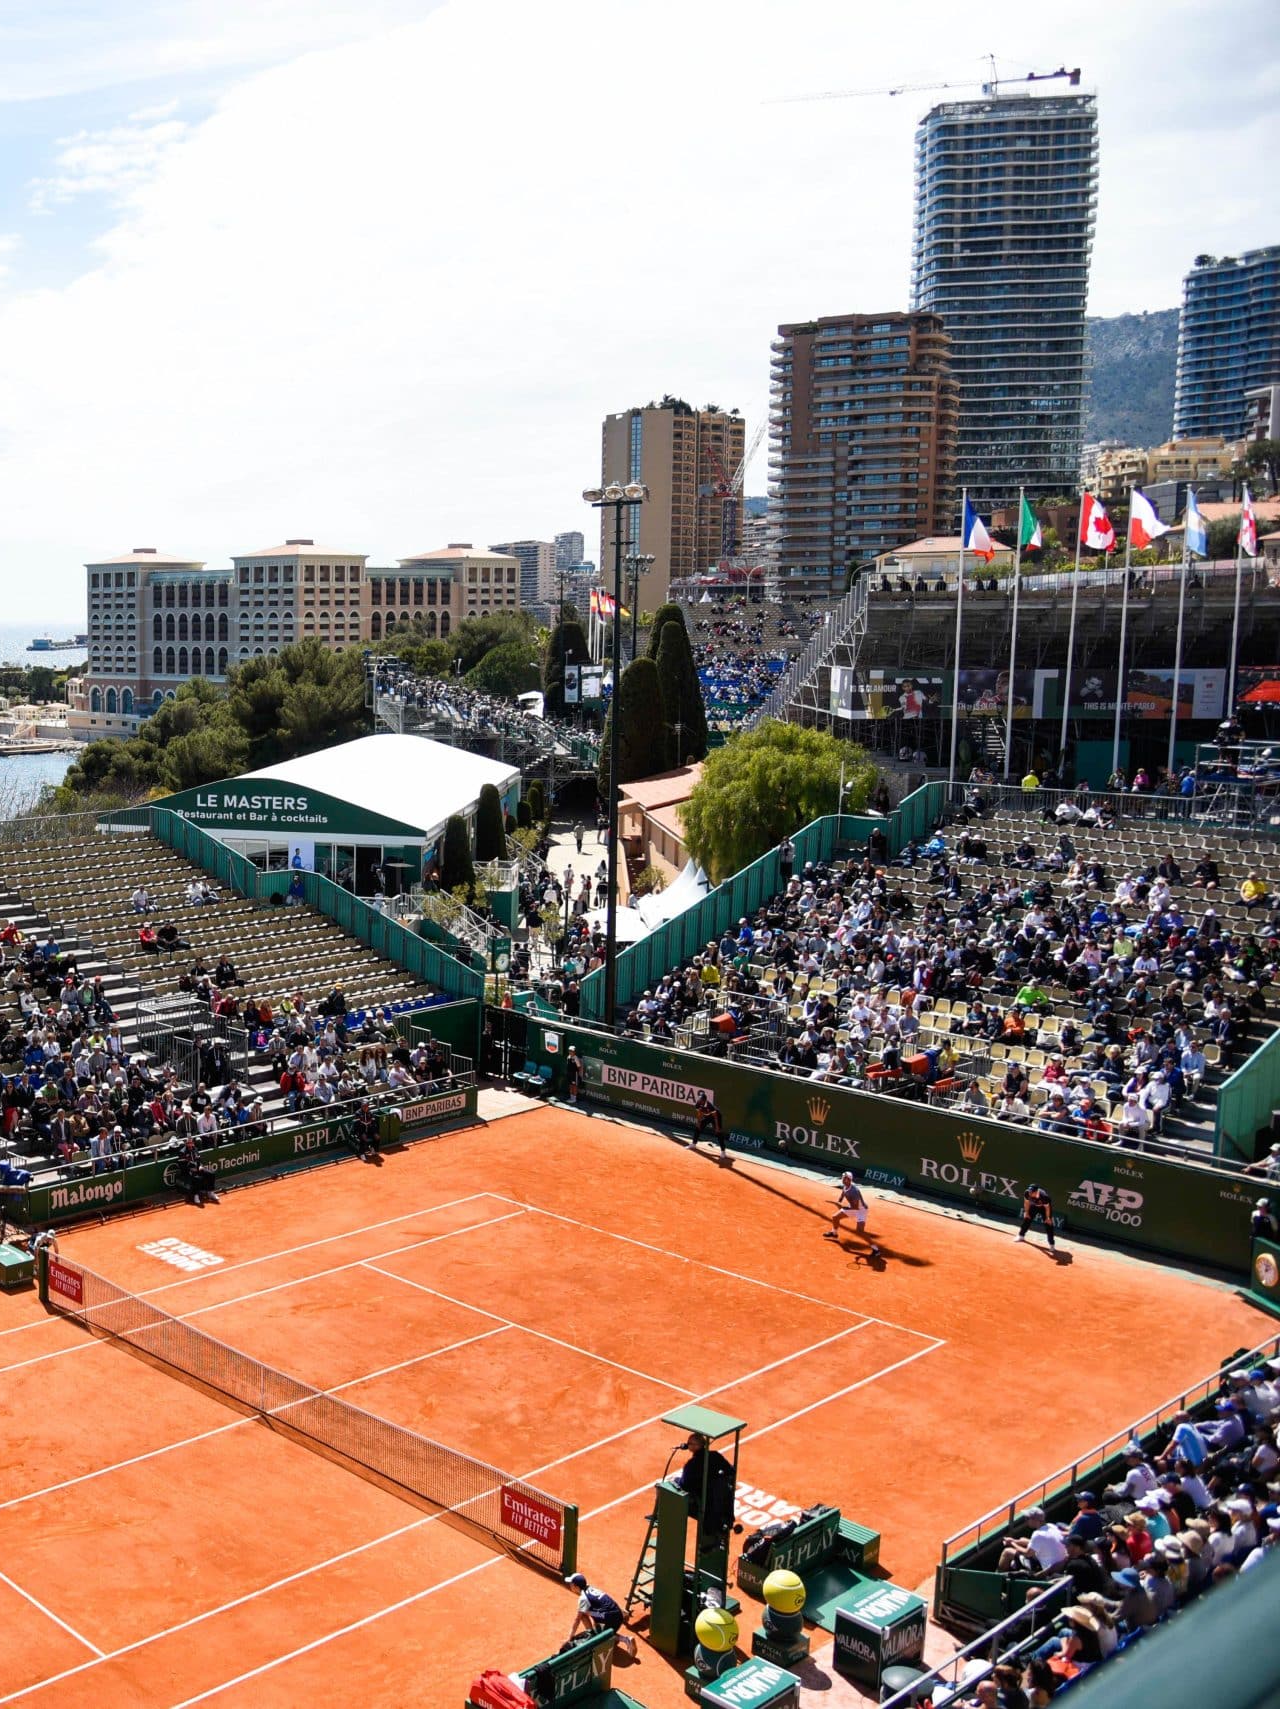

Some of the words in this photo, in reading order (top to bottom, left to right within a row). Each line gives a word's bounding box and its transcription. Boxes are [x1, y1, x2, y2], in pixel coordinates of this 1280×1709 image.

[1083, 702, 1099, 711] THIS
[196, 793, 218, 807] LE
[223, 794, 308, 810] MASTERS
[177, 809, 233, 821] Restaurant
[249, 813, 268, 821] Bar
[271, 813, 278, 822] à
[280, 814, 328, 824] cocktails
[607, 1066, 638, 1087] BNP
[662, 1060, 682, 1071] ROLEX
[405, 1106, 423, 1121] BNP
[425, 1096, 462, 1116] PARIBAS
[728, 1132, 764, 1149] REPLAY
[775, 1121, 861, 1159] ROLEX
[219, 1149, 260, 1174] Tacchini
[1114, 1165, 1144, 1180] ROLEX
[864, 1169, 905, 1186] REPLAY
[920, 1157, 1020, 1199] ROLEX
[51, 1178, 123, 1209] Malongo
[1068, 1179, 1144, 1211] ATP
[1220, 1190, 1253, 1204] ROLEX
[1067, 1199, 1105, 1214] MASTERS
[1105, 1206, 1142, 1227] 1000
[50, 1266, 81, 1289] Emirates
[503, 1492, 557, 1530] Emirates
[511, 1511, 523, 1526] FLY
[523, 1518, 549, 1540] BETTER
[773, 1524, 839, 1571] REPLAY
[738, 1570, 764, 1585] REPLA
[835, 1633, 876, 1662] VALMORA
[881, 1623, 924, 1660] VALMORA
